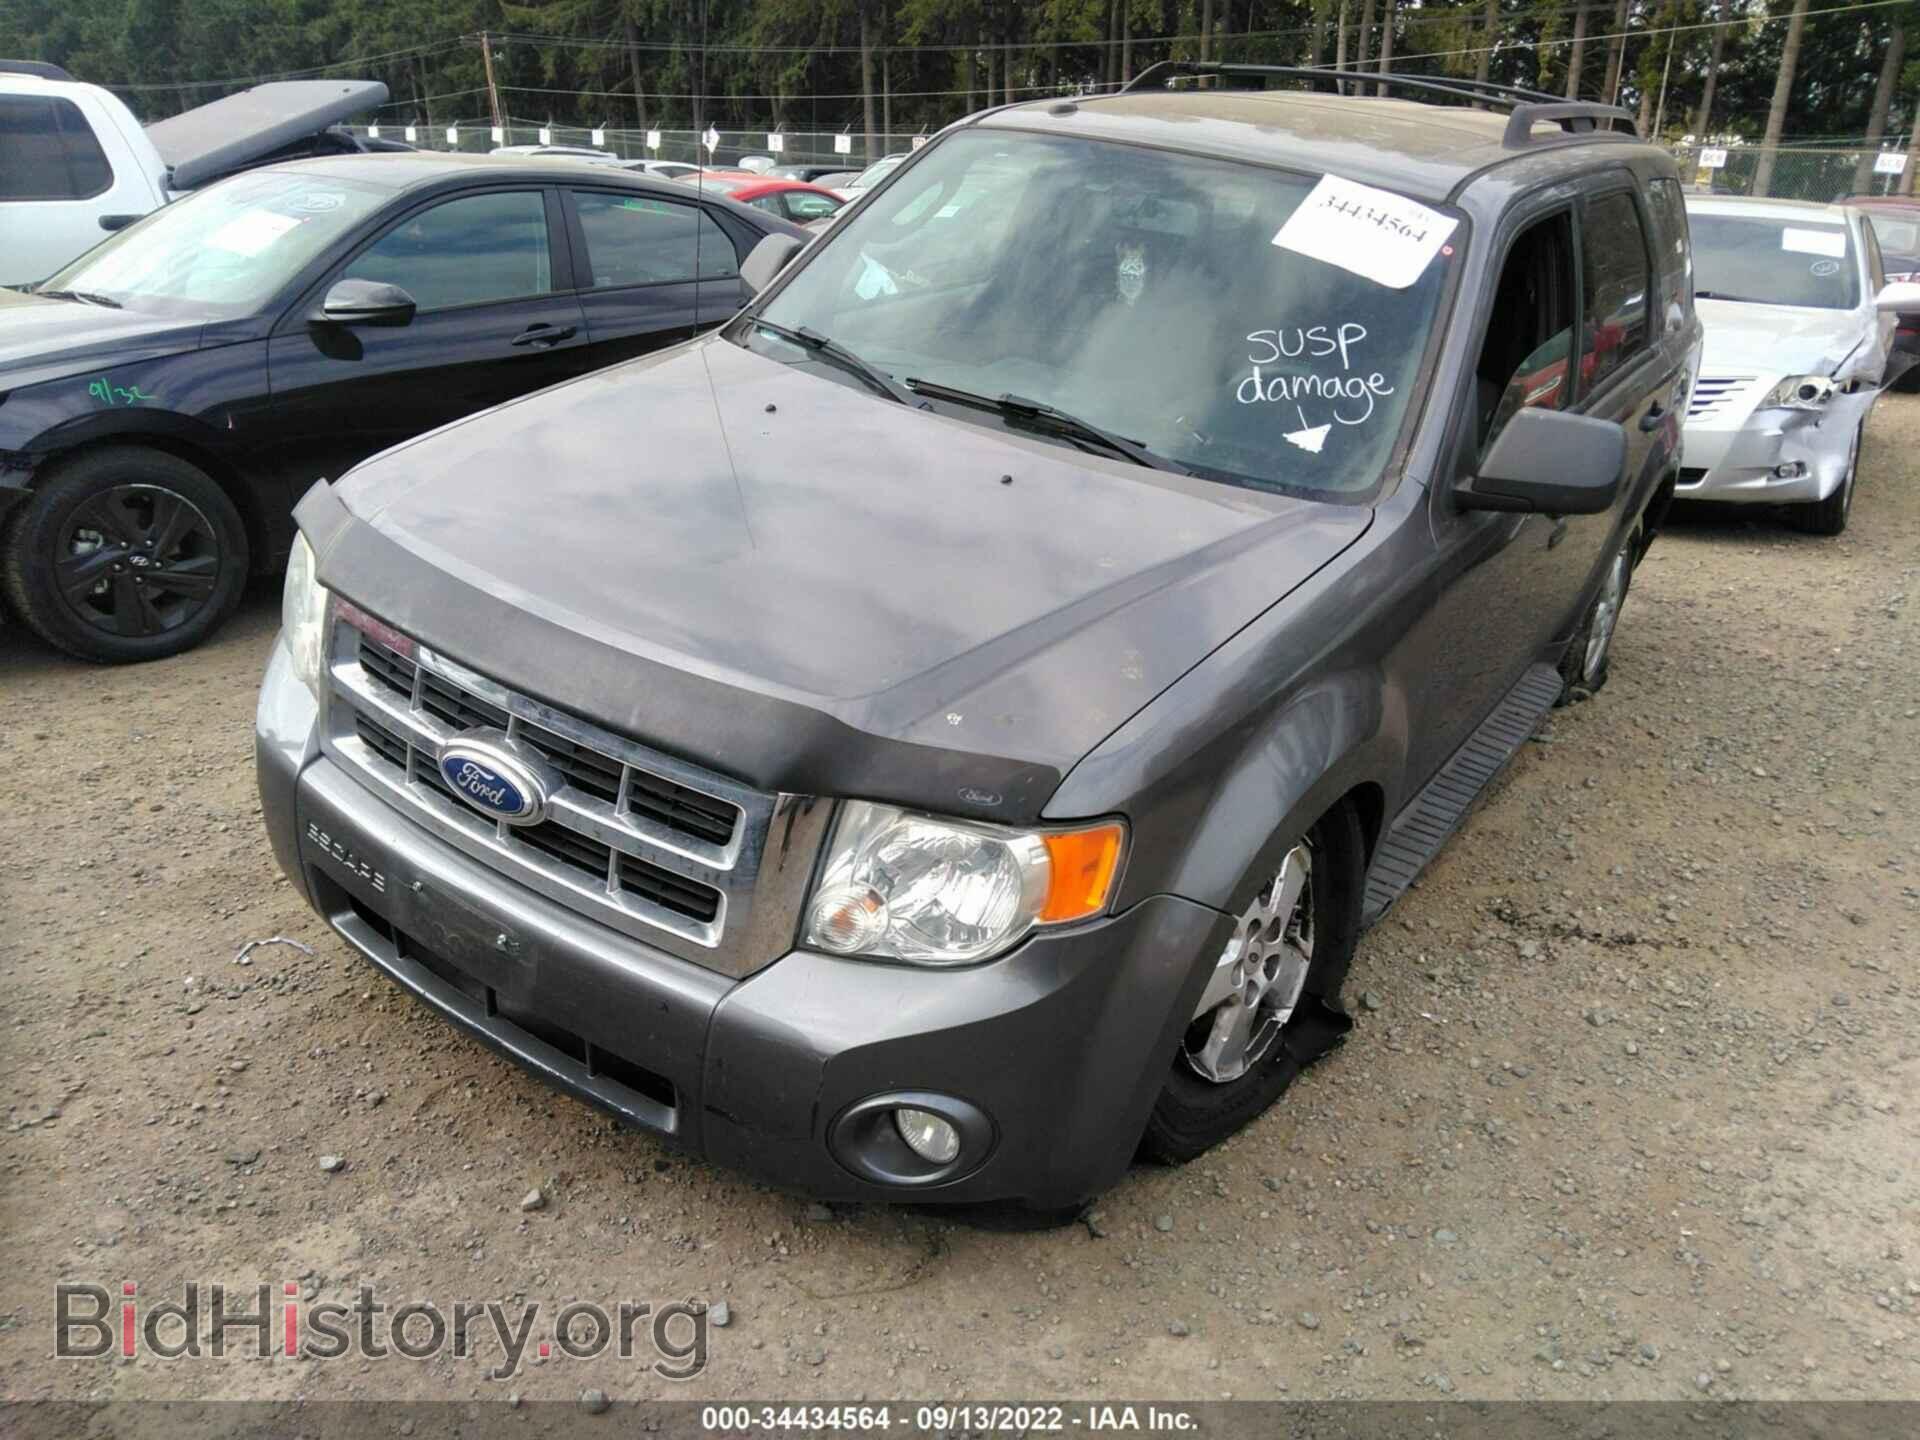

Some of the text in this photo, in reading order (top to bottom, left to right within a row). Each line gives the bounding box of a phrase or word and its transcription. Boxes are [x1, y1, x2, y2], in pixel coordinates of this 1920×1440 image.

[1237, 366, 1394, 425] damage
[456, 761, 507, 807] Ford
[306, 823, 385, 893] ESCAPE
